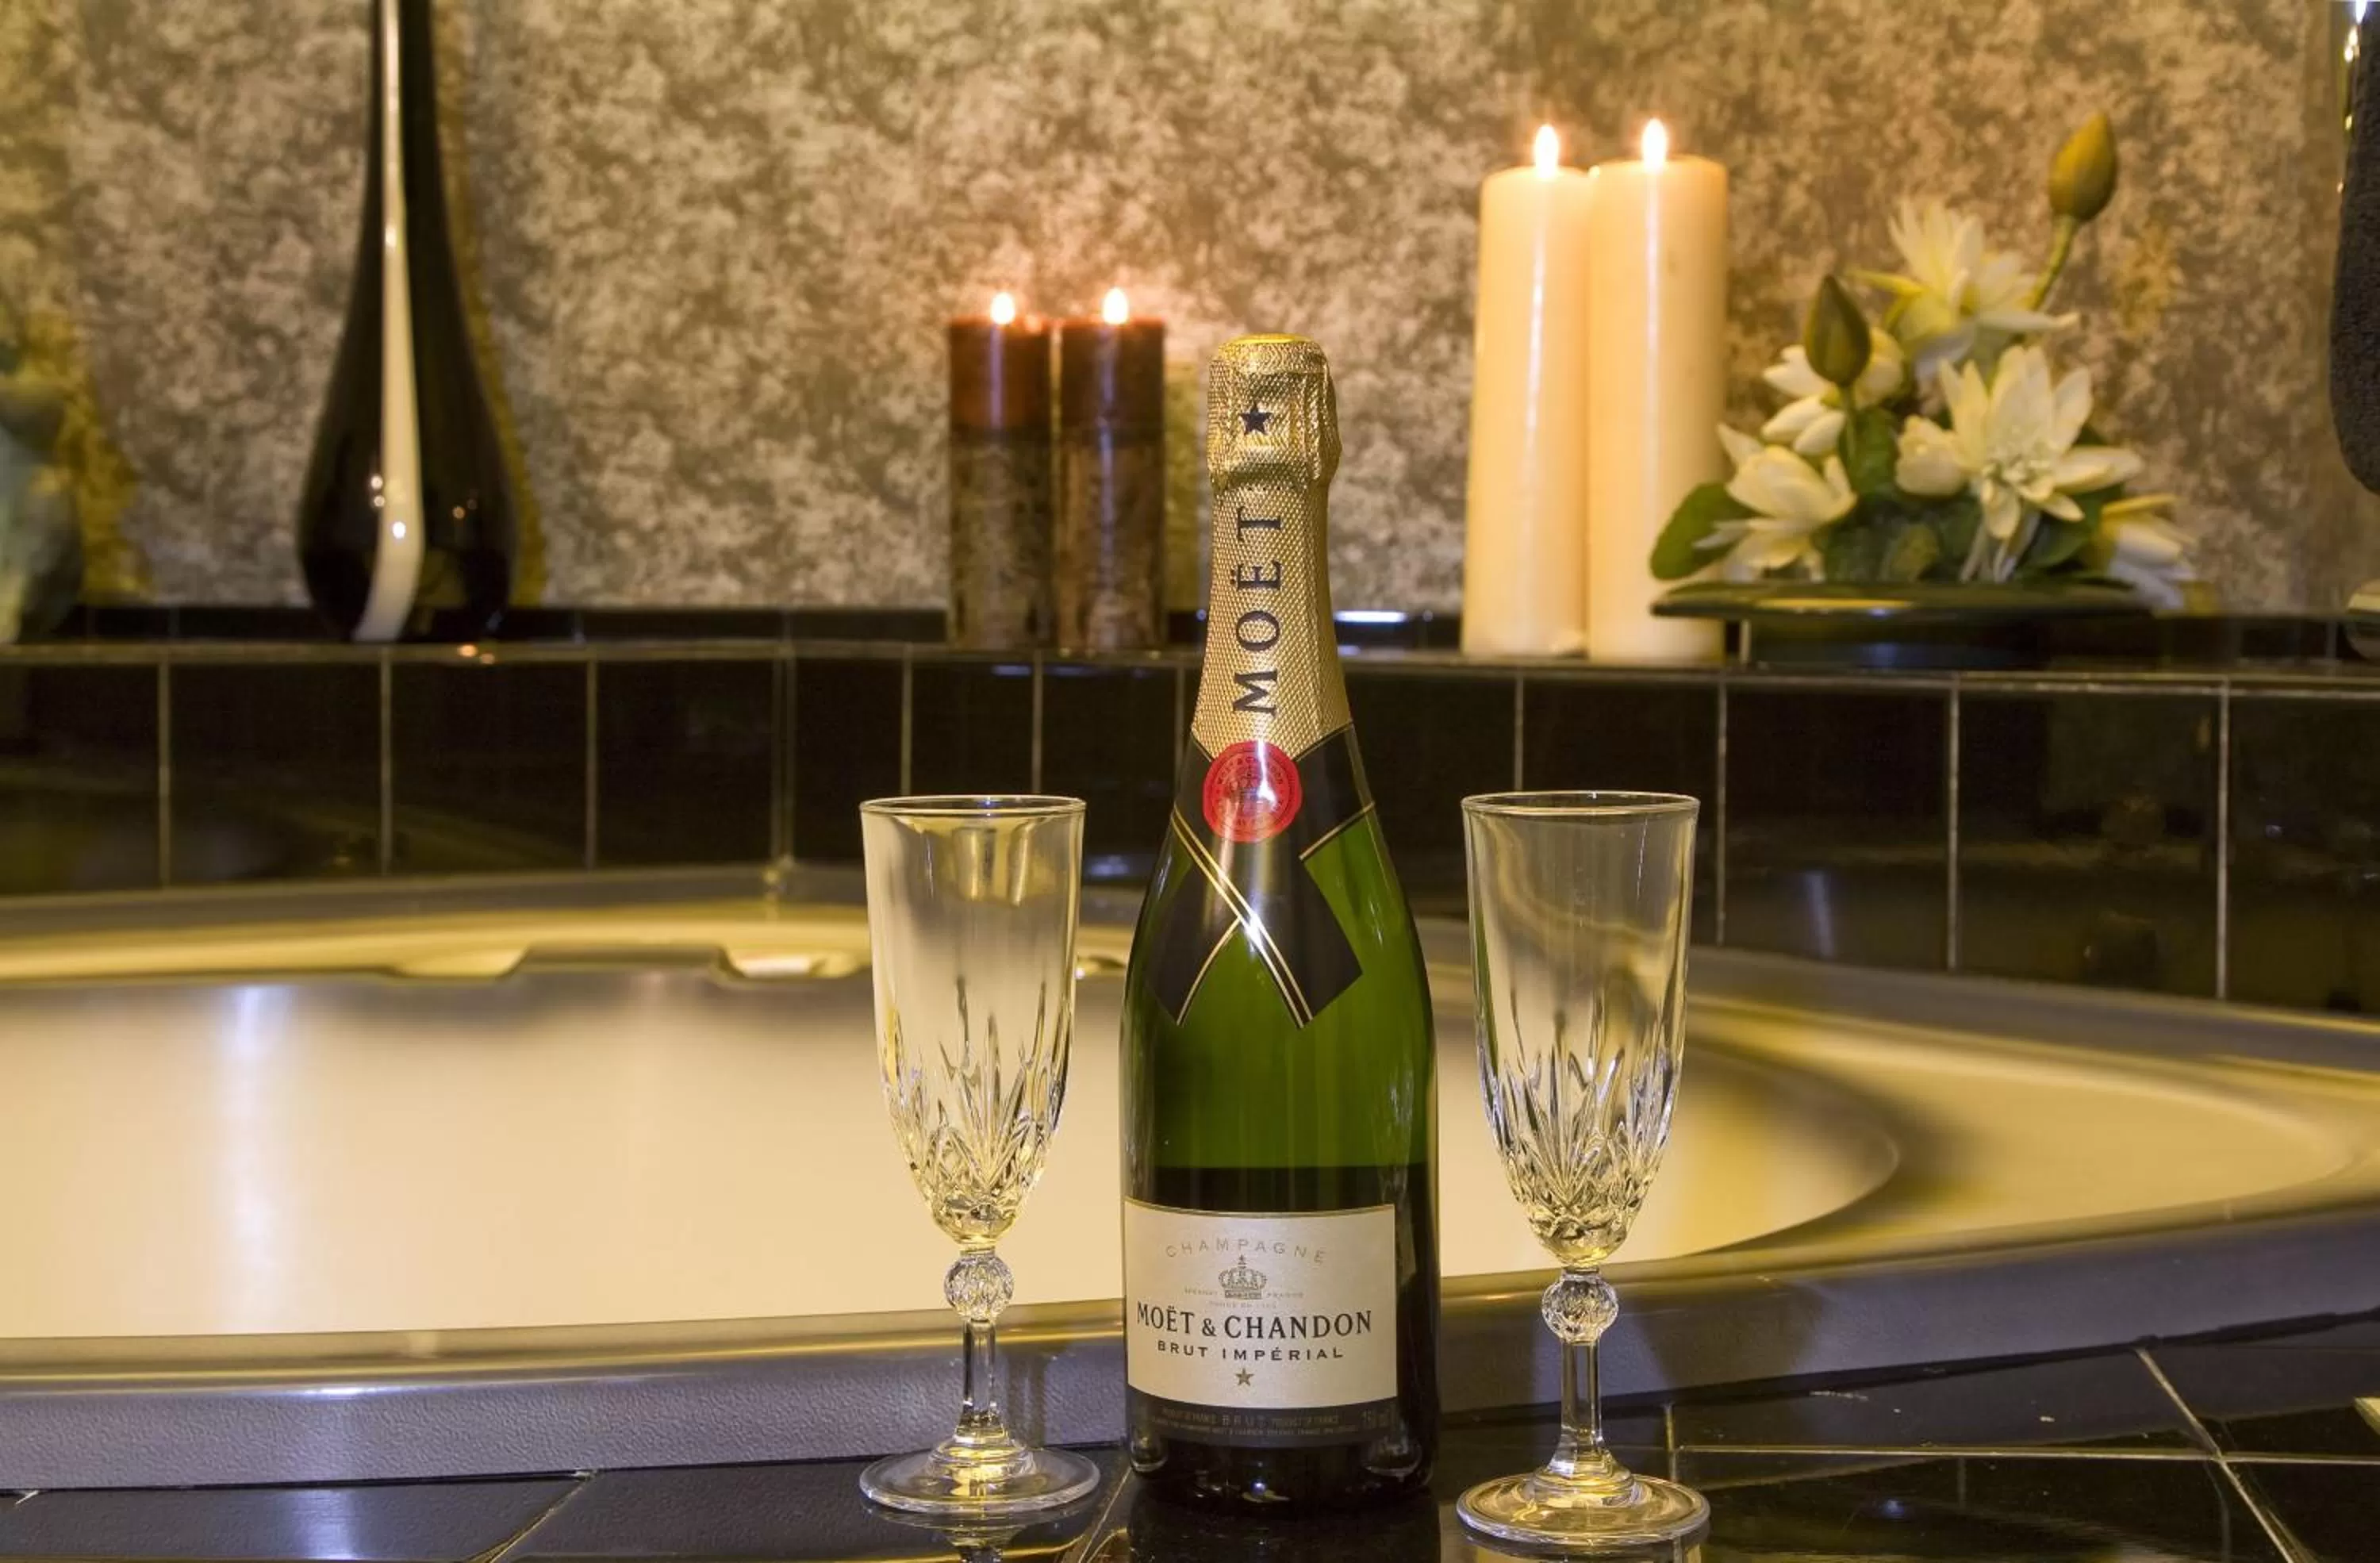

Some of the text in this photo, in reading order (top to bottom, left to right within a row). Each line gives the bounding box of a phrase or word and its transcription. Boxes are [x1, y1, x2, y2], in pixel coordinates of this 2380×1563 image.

[1231, 506, 1282, 716] MOËT
[1165, 1238, 1327, 1265] CHAMPAGNE
[1137, 1301, 1372, 1339] MOËT & CHANDON
[1157, 1340, 1344, 1361] BRUT IMPÉRIAL
